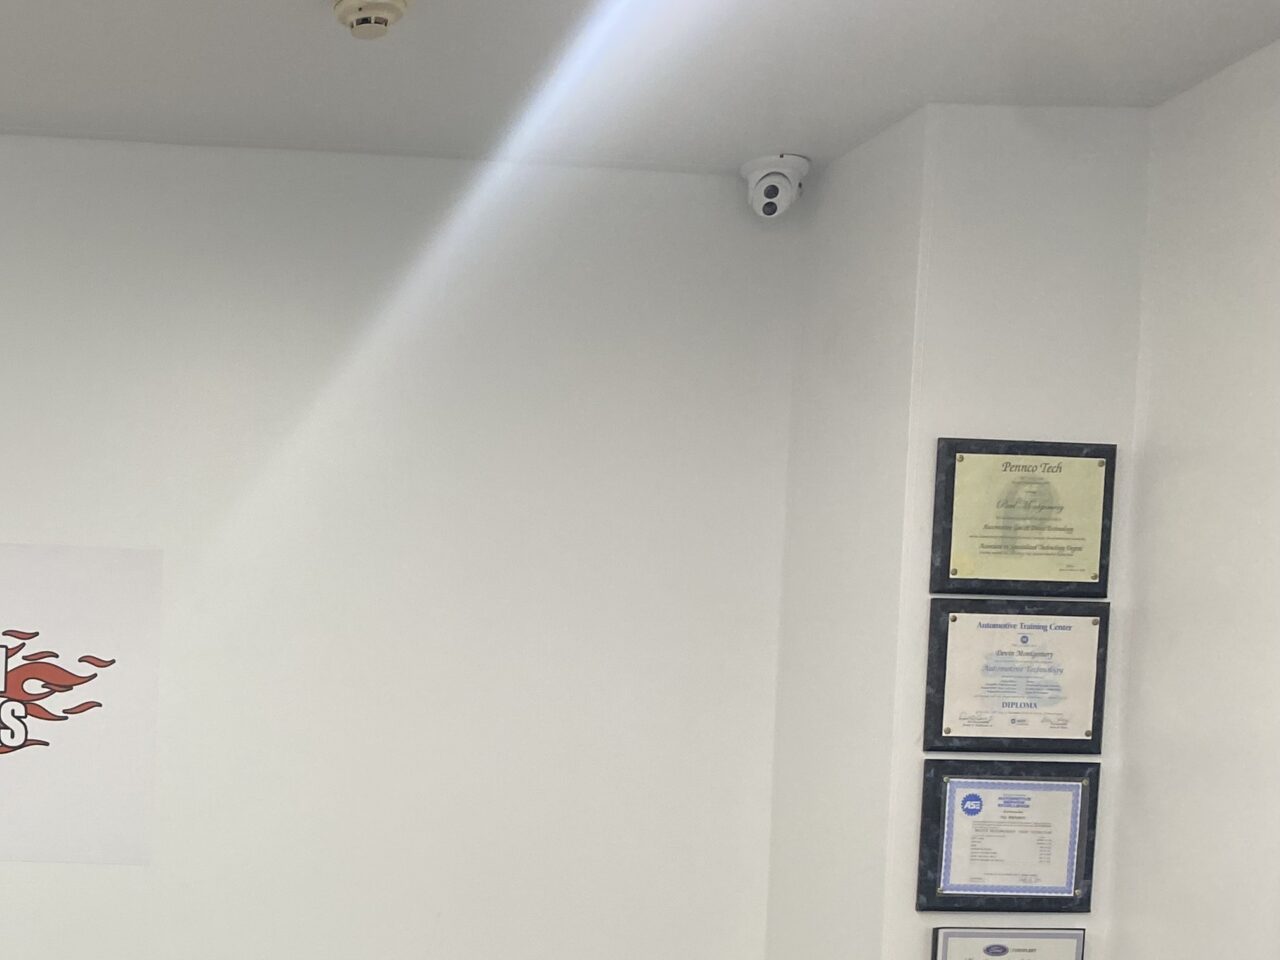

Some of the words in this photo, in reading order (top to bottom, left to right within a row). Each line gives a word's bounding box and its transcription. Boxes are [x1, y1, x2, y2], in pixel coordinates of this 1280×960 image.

[1001, 461, 1038, 473] Pennco
[1039, 462, 1063, 474] Tech
[977, 622, 1017, 630] Automotive
[1019, 623, 1048, 632] Training
[1049, 623, 1072, 631] Center
[1001, 701, 1038, 710] DIPLOMA
[963, 800, 981, 810] ASE
